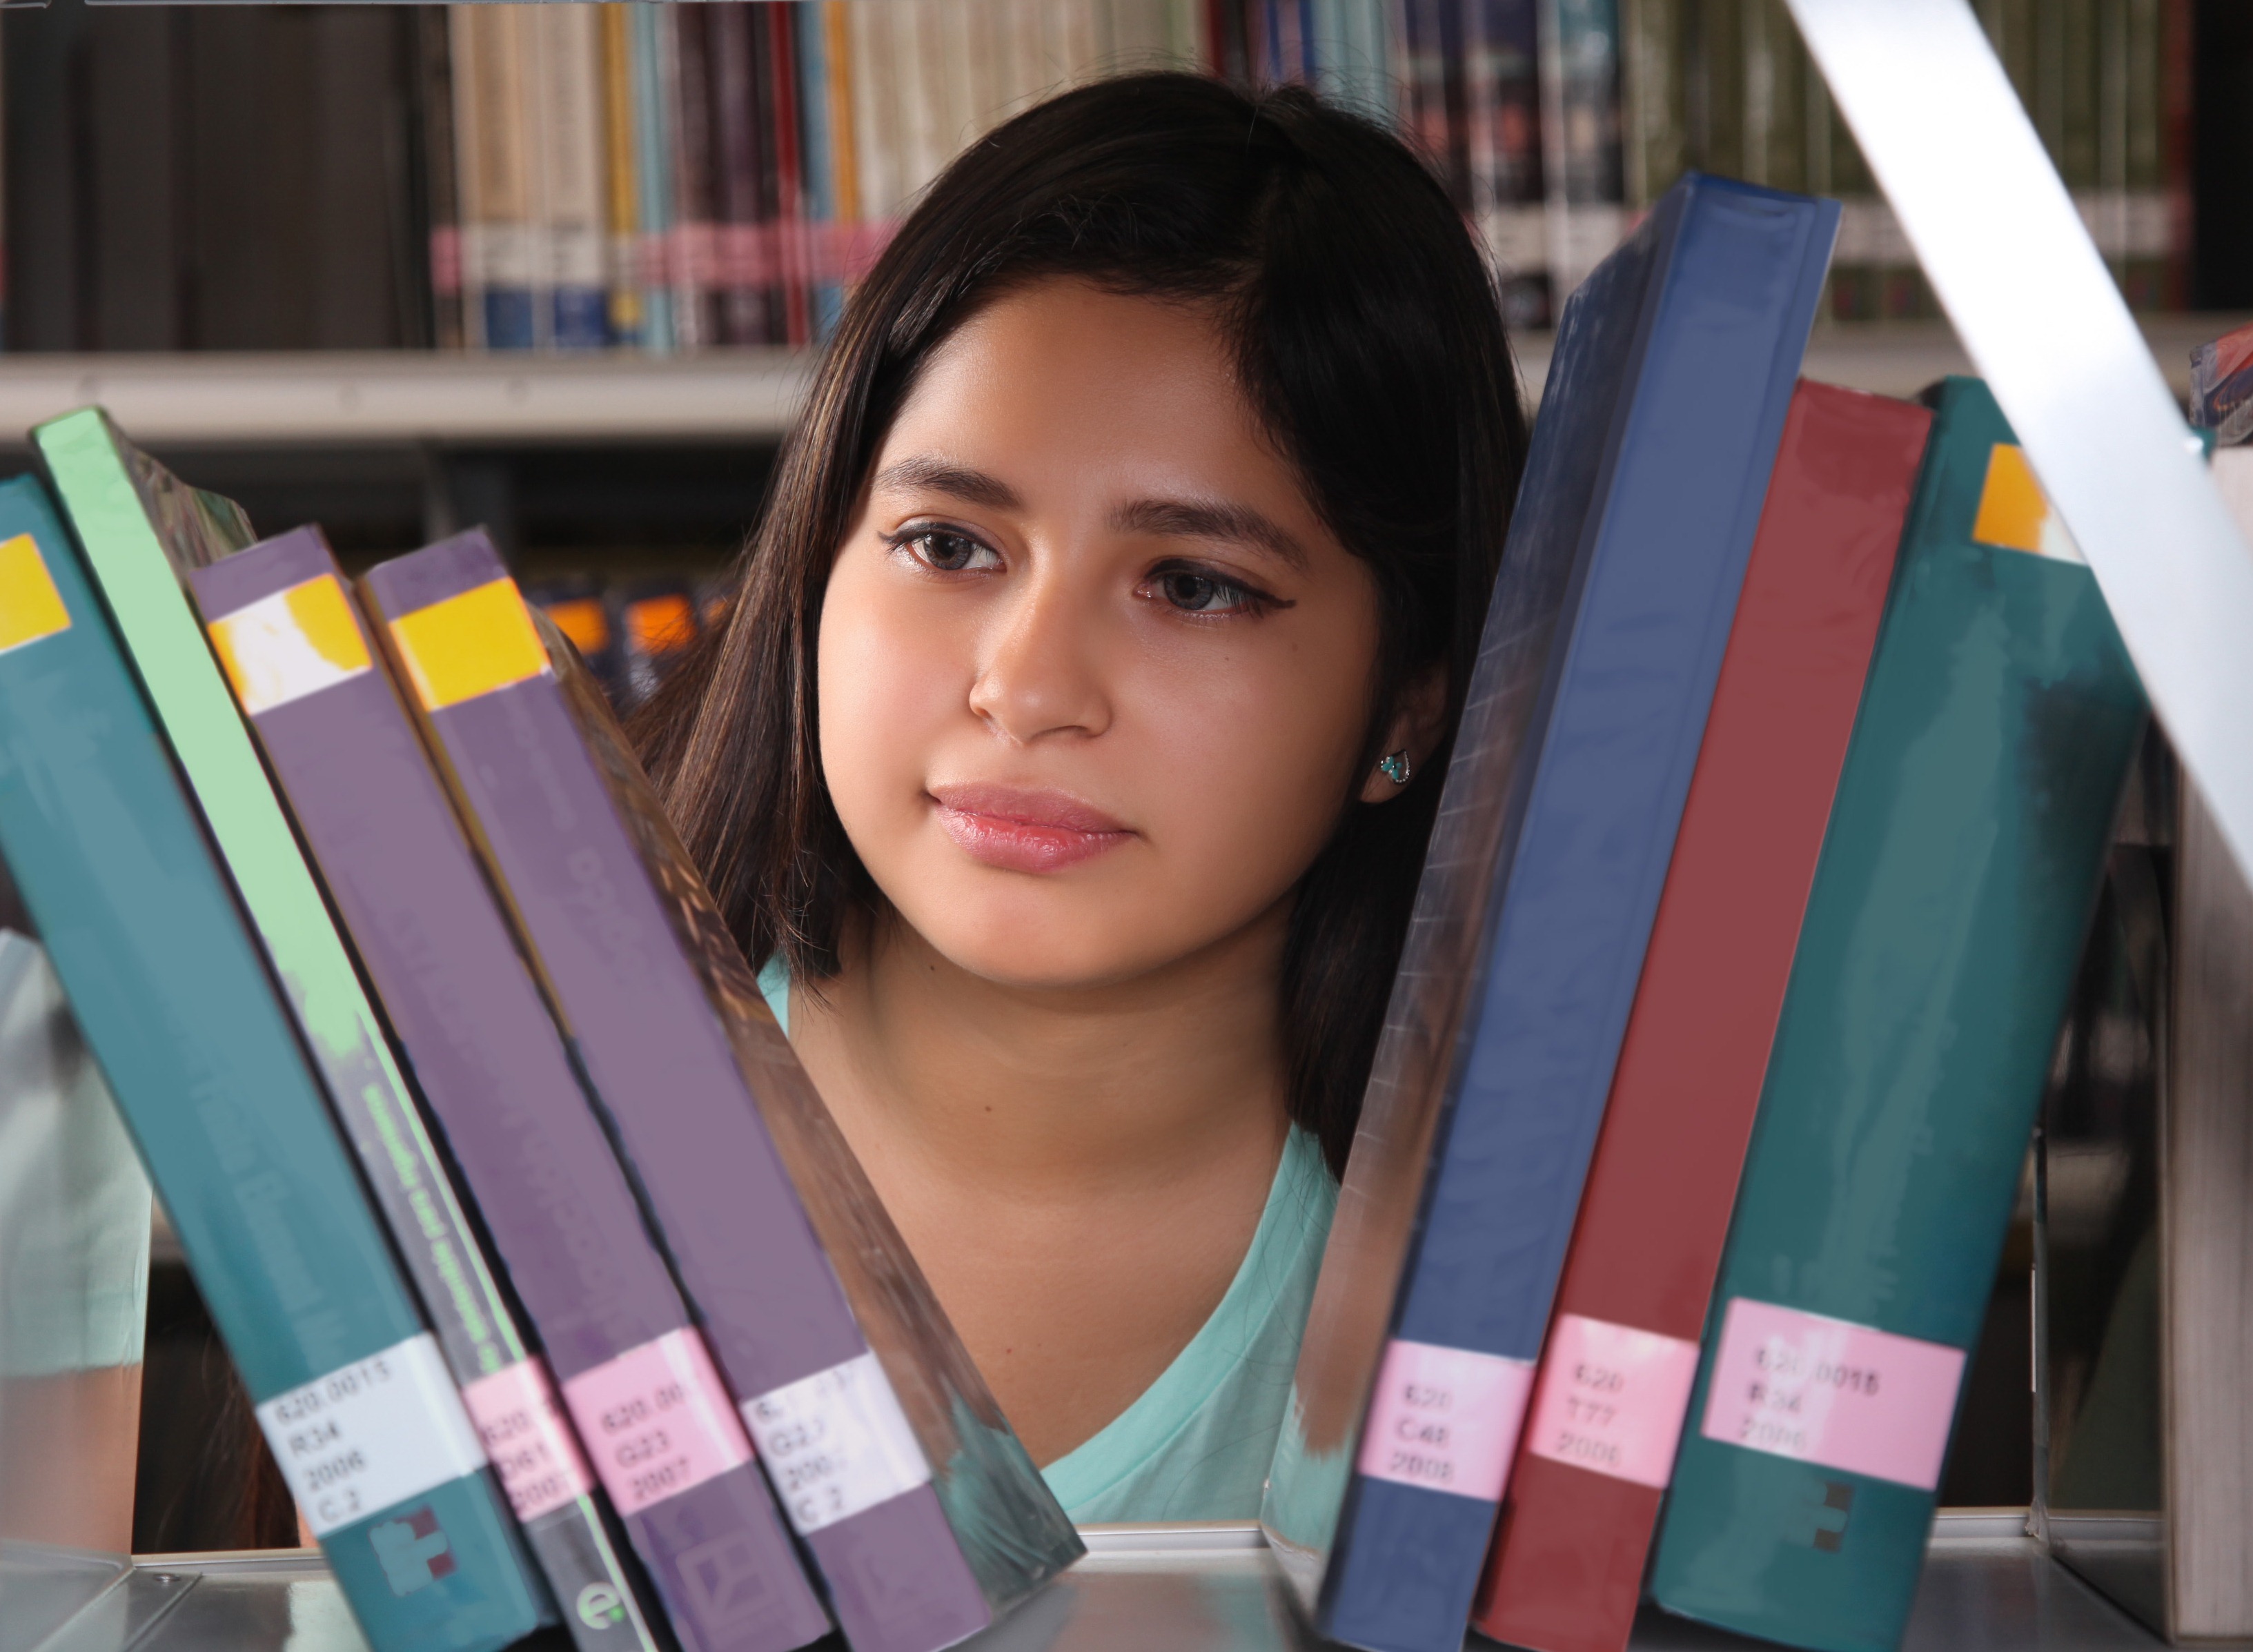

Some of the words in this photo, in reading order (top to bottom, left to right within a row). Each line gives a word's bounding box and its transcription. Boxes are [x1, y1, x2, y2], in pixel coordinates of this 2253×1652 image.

[1573, 1363, 1624, 1393] 620
[288, 1420, 341, 1457] R34
[304, 1448, 366, 1491] 2006
